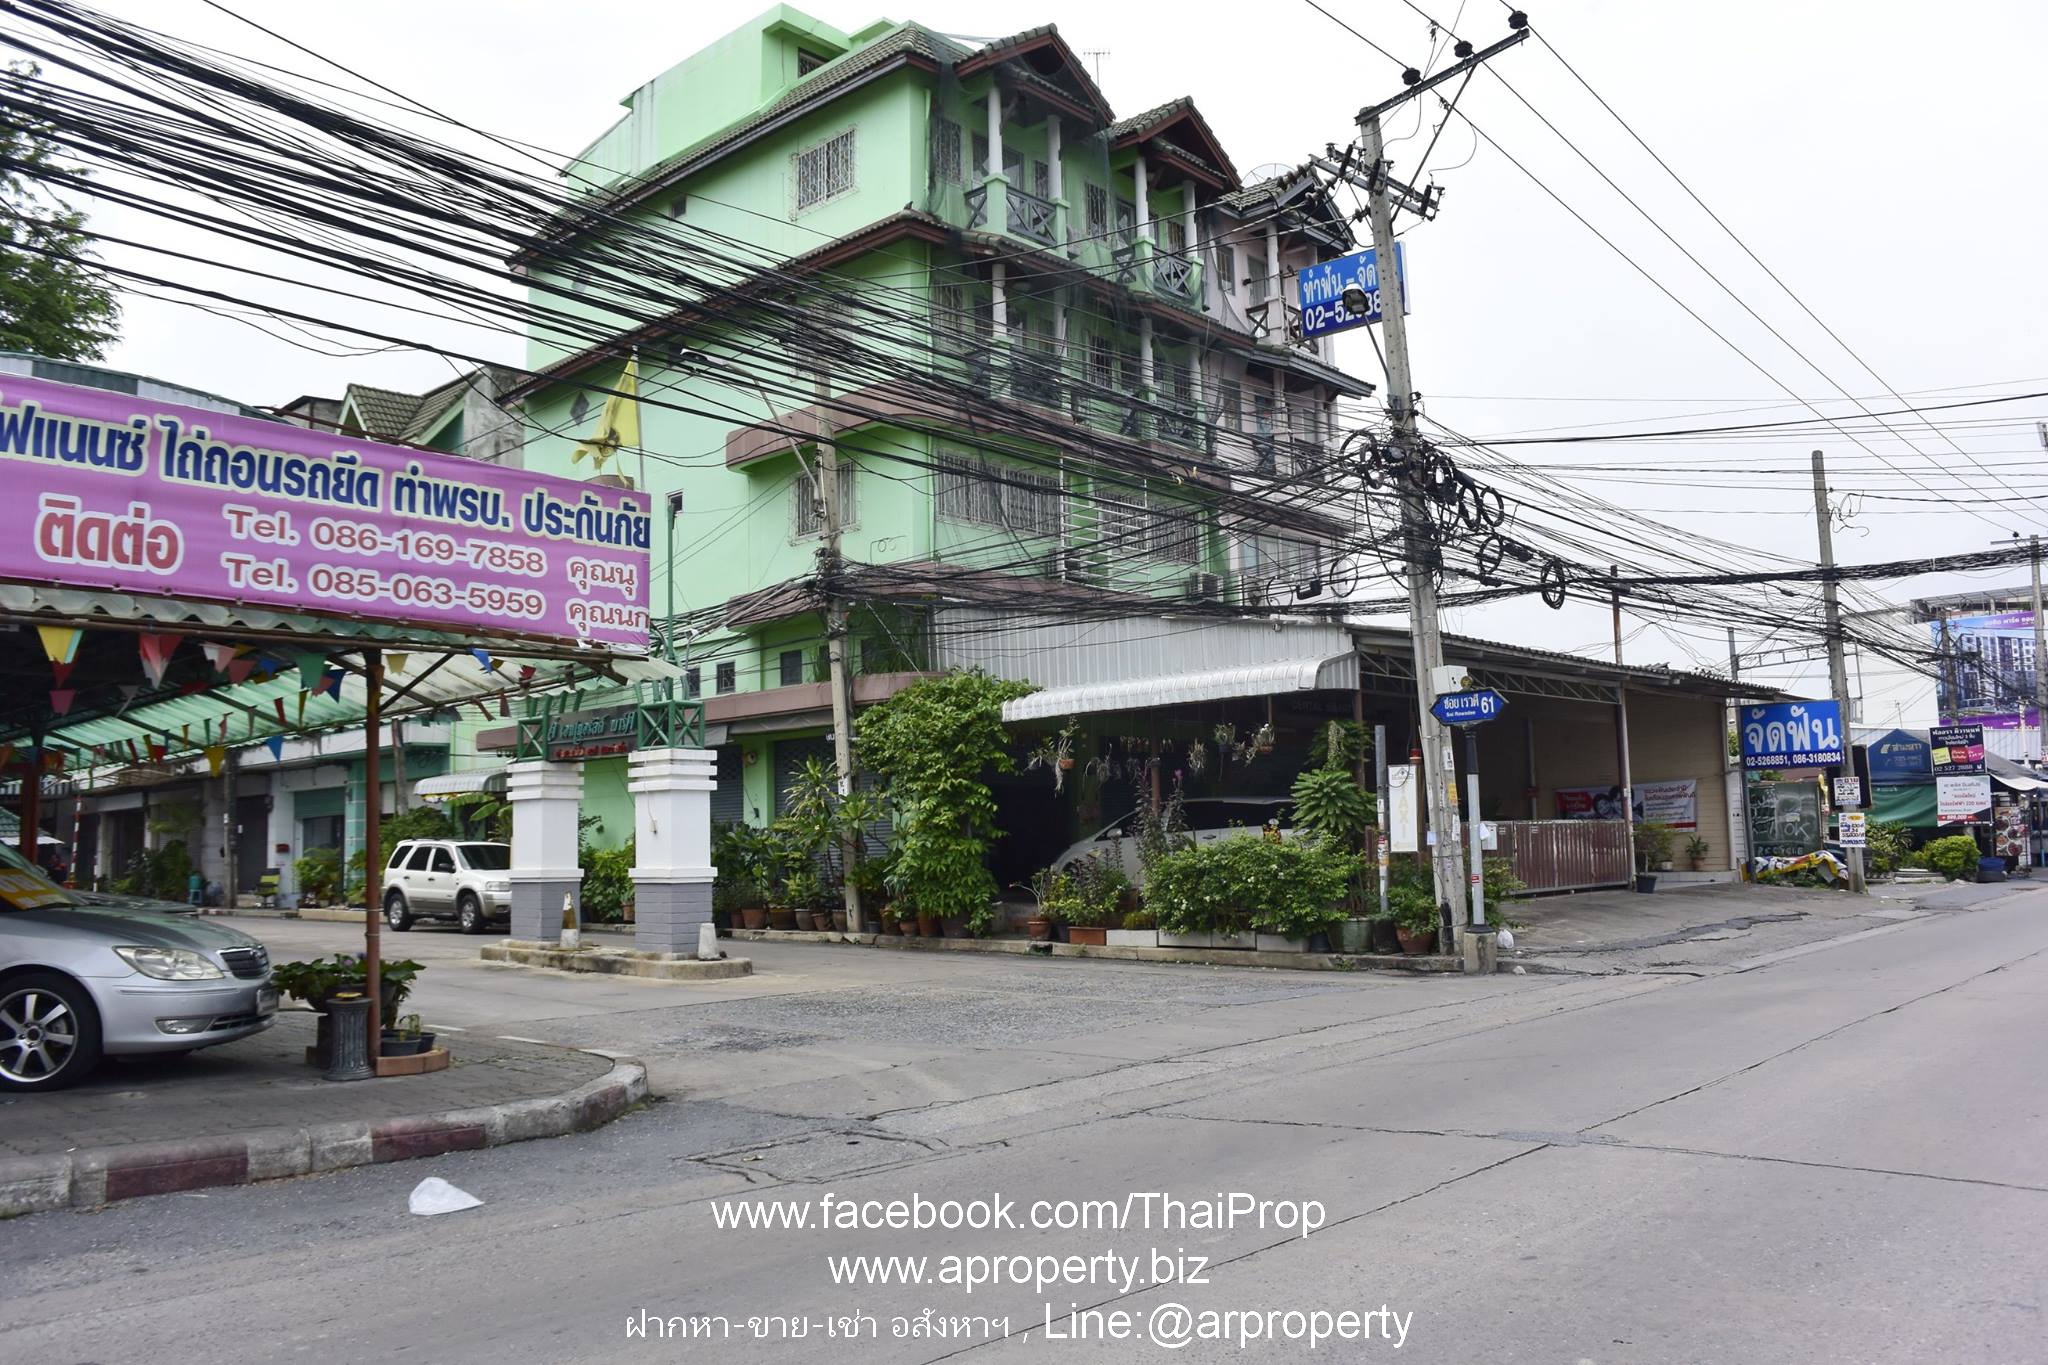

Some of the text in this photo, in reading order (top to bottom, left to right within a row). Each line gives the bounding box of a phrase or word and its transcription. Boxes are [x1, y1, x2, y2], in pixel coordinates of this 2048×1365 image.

[159, 419, 380, 508] ไถ่ถอนรถยึด
[394, 465, 510, 528] ทำพรบ.
[524, 491, 650, 549] ประกันภัย
[40, 498, 179, 570] ติดต่อ
[228, 509, 635, 597] Tel. 086-169-7858 คุณนุ
[225, 557, 294, 588] Tel.
[312, 569, 543, 615] 085-063-5959
[1443, 693, 1495, 714] ซอย เรวดี 61
[1745, 704, 1840, 753] จัดฟัน
[1793, 752, 1841, 764] 086-3180834
